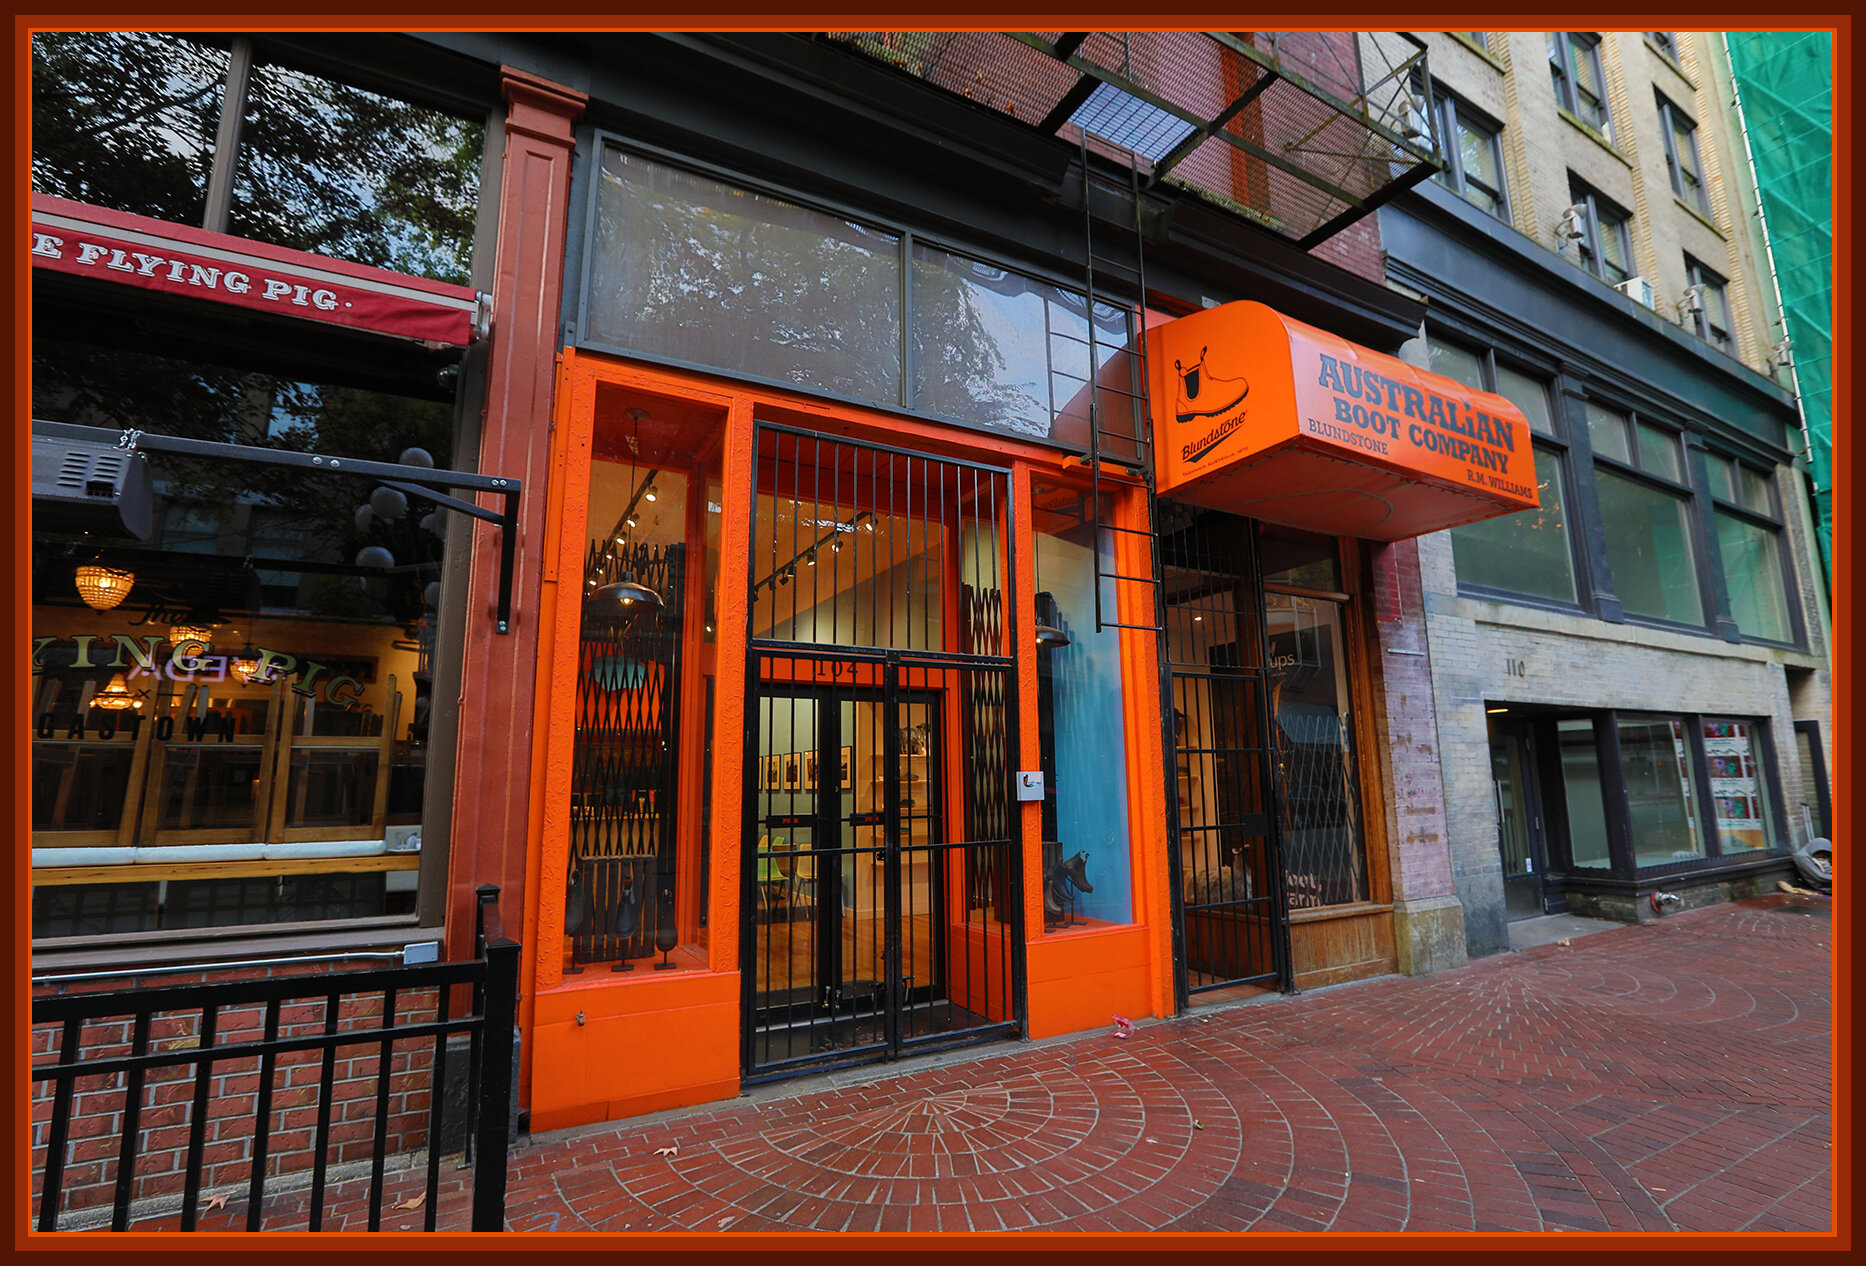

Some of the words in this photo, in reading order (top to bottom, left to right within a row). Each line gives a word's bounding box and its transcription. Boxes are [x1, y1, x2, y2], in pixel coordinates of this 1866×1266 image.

[75, 241, 252, 294] FLYING
[1181, 411, 1246, 460] Blundstone
[1308, 418, 1389, 456] BLUNDSTONE
[1333, 396, 1401, 440] BOOT
[1408, 423, 1508, 474] COMPANY
[1466, 469, 1487, 486] R.M.
[1488, 475, 1533, 499] WILLIAMS
[246, 647, 364, 710] PIG
[817, 659, 858, 677] 104
[1506, 658, 1526, 678] 110
[37, 713, 236, 741] GASTOWN
